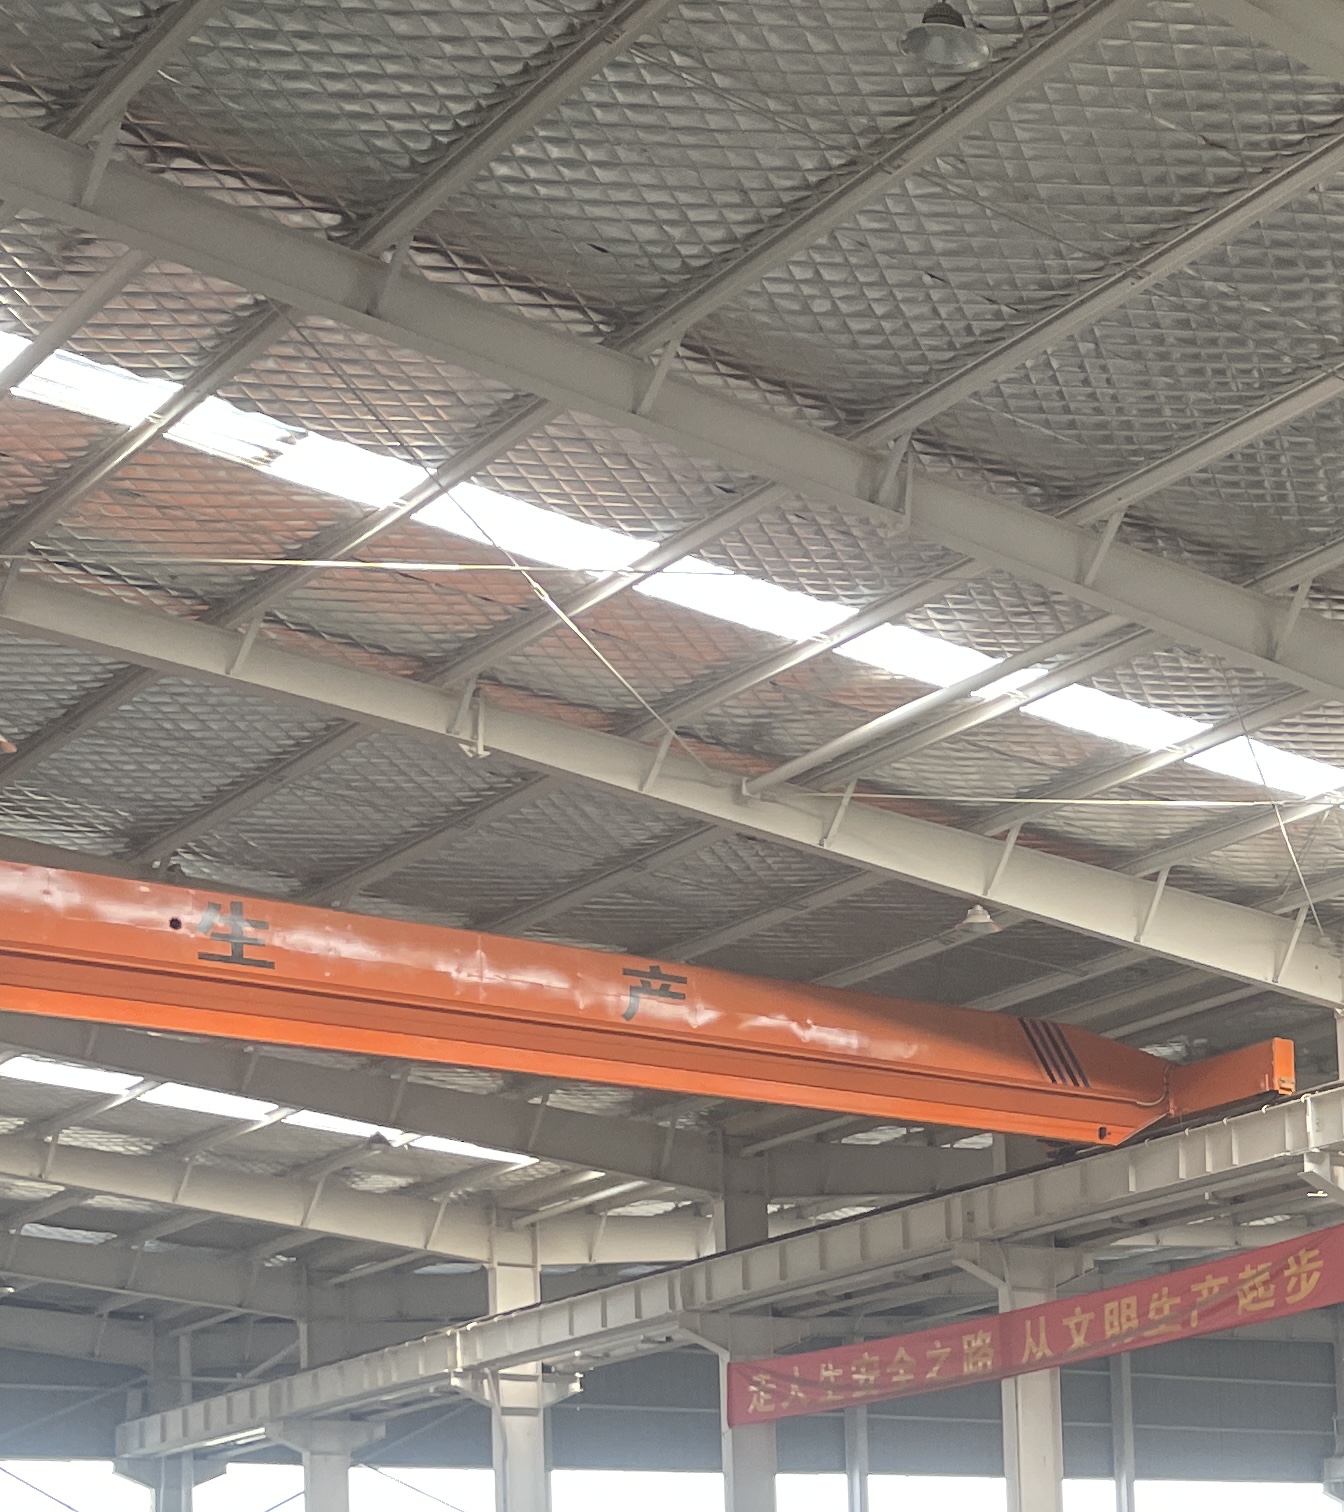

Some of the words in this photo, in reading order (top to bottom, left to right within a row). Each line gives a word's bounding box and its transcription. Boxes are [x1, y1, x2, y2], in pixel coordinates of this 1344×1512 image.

[197, 901, 275, 970] 生
[622, 965, 688, 1022] 产
[1021, 1248, 1324, 1364] 从文明生产起步
